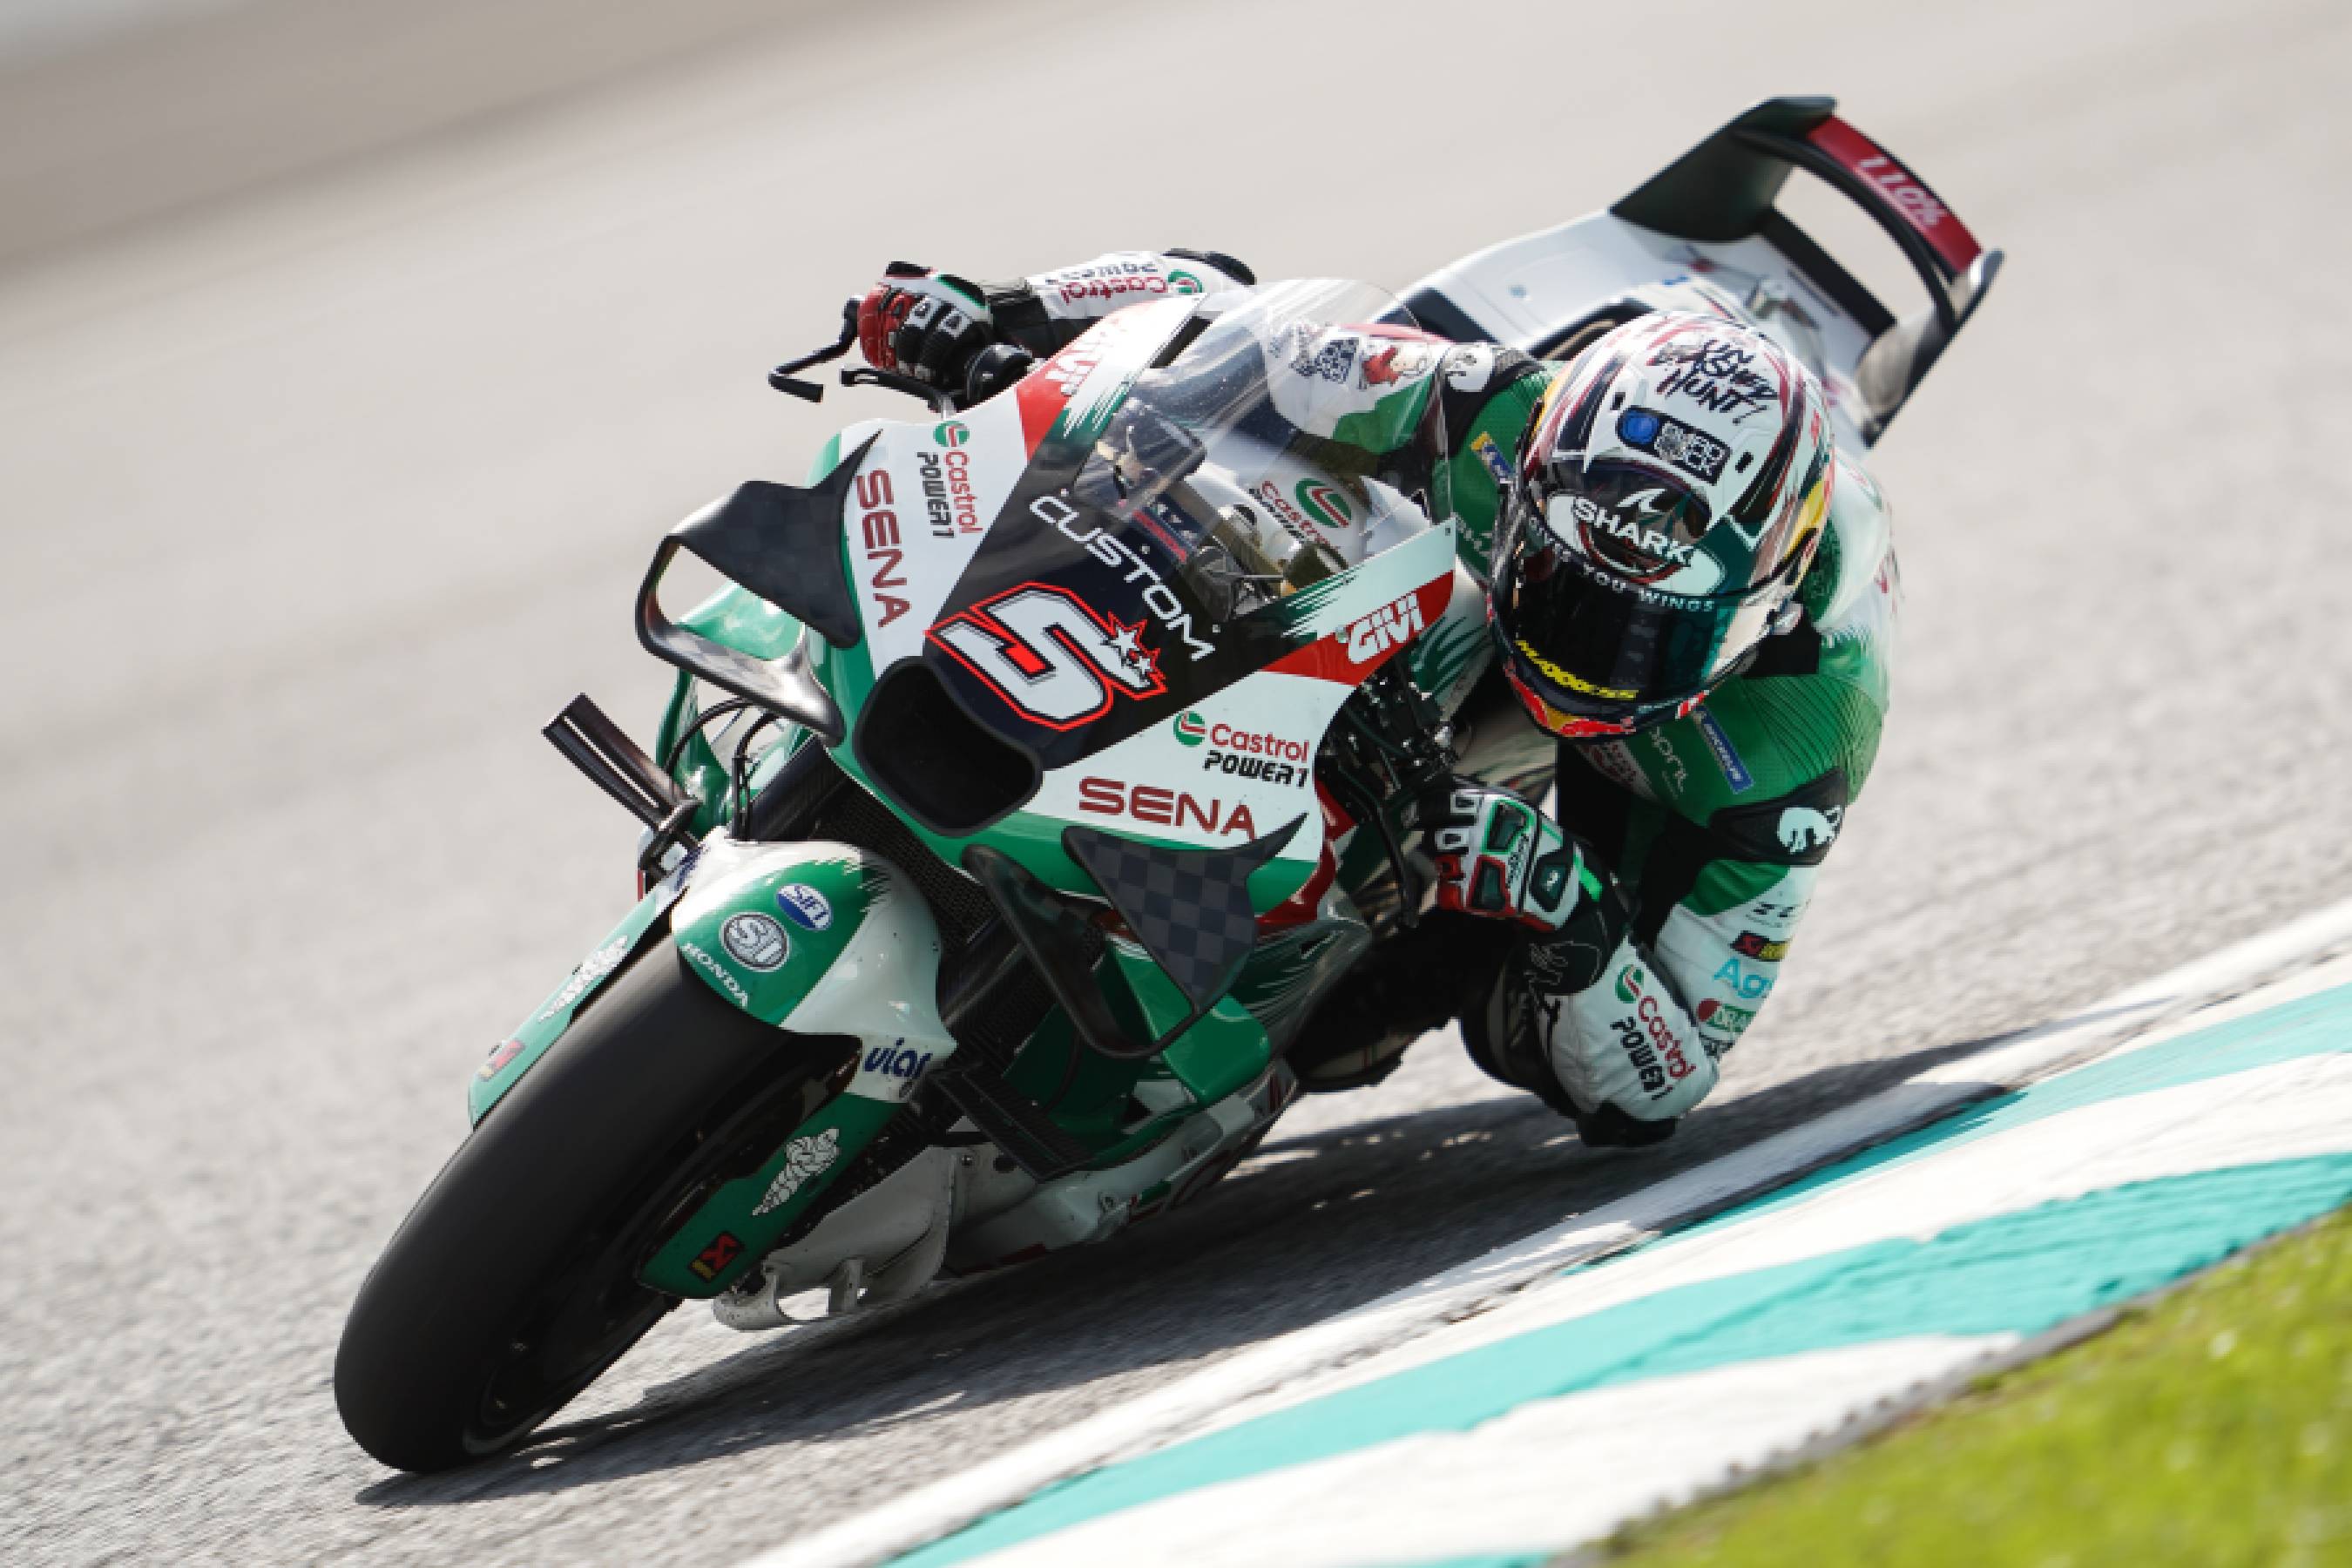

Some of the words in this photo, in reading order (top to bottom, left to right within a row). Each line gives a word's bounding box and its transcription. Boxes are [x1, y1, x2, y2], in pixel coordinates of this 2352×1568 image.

[1059, 277, 1168, 307] Castrol
[943, 451, 983, 534] Castrol
[1260, 480, 1342, 551] Castro
[856, 469, 910, 627] SENA
[1572, 497, 1695, 567] SHARK
[1030, 496, 1215, 661] CUSTOM
[1583, 565, 1626, 594] YOU
[1639, 589, 1715, 613] WINGS
[925, 582, 1166, 730] 5
[1347, 593, 1423, 663] GIVI
[1210, 722, 1308, 763] Castrol
[1078, 776, 1256, 841] SENA
[680, 942, 749, 1007] HONDA
[1713, 957, 1774, 999] Ag
[1639, 996, 1696, 1080] Castrol
